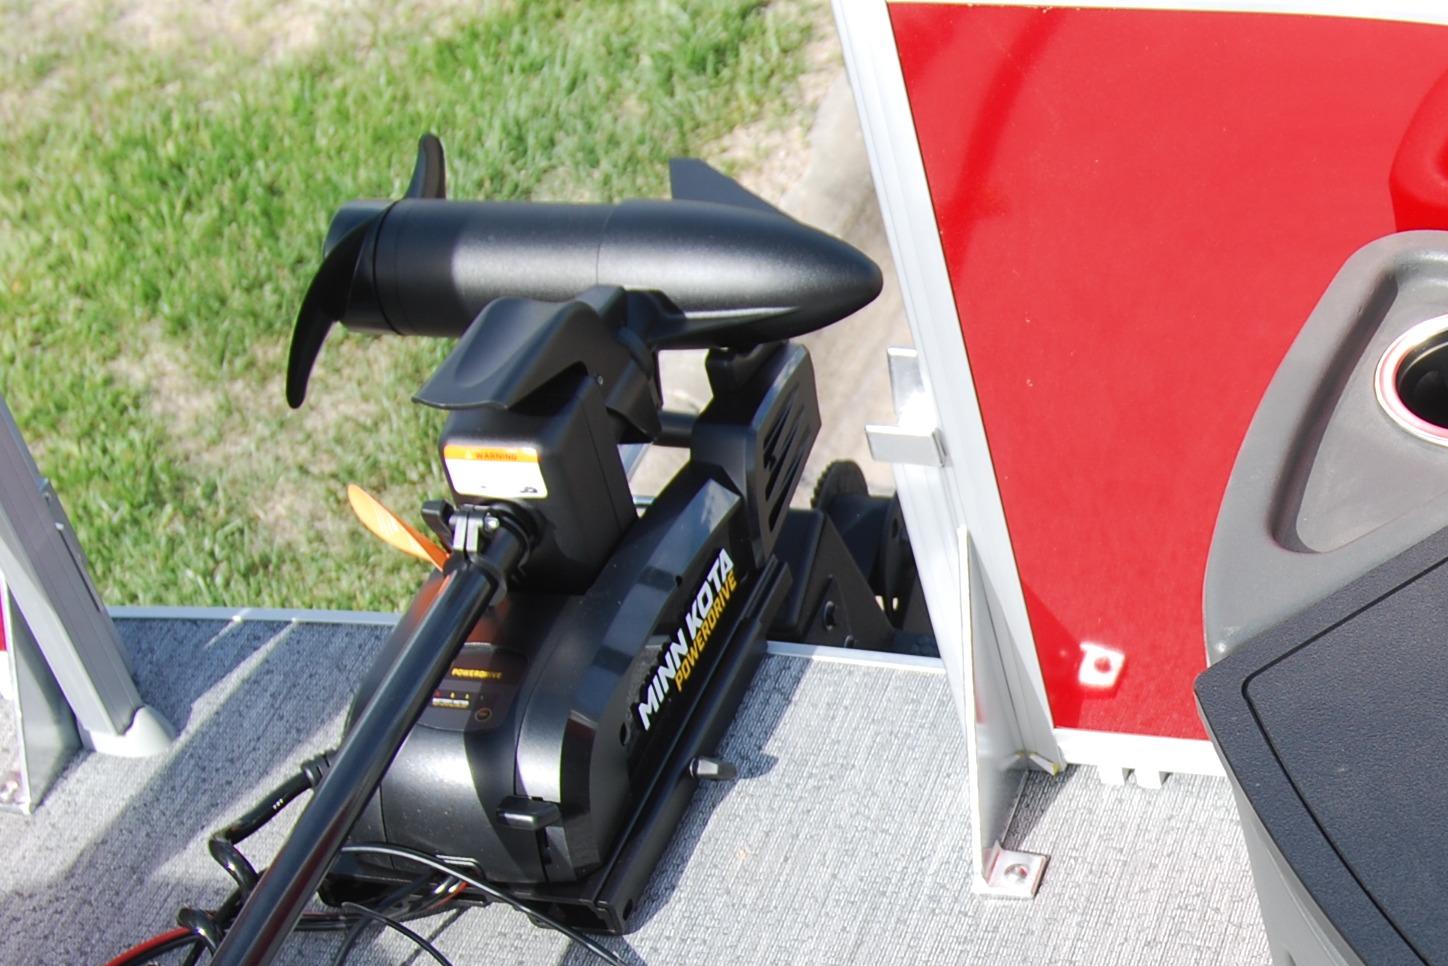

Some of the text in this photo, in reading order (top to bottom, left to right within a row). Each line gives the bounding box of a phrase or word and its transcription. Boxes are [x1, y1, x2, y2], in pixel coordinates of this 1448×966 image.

[638, 548, 734, 731] MINN KOTA
[674, 570, 737, 692] POWERDRIVE
